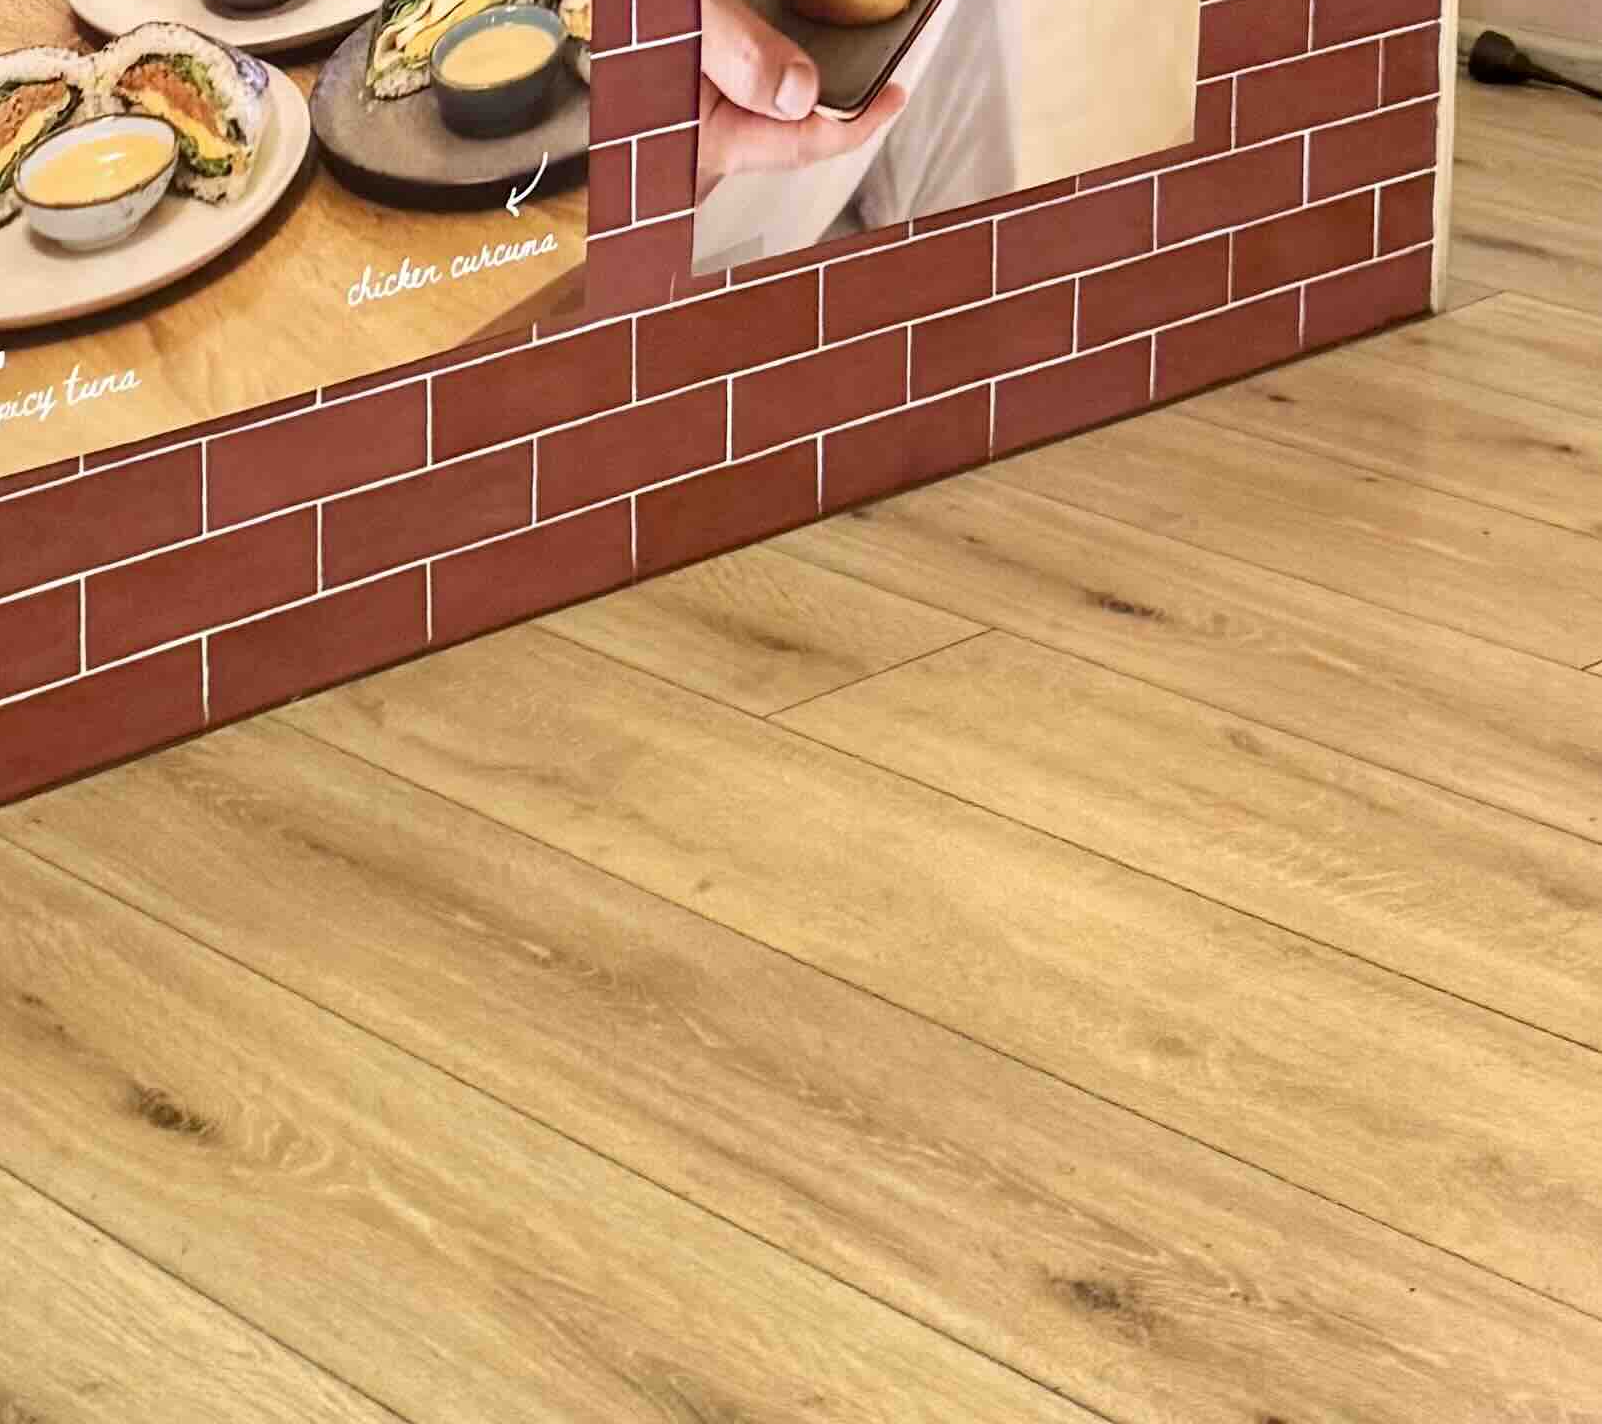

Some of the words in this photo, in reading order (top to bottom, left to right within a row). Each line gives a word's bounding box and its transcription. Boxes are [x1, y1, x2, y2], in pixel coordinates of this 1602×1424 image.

[347, 256, 443, 306] chicken
[450, 232, 558, 278] curcuma
[63, 364, 143, 407] tuna
